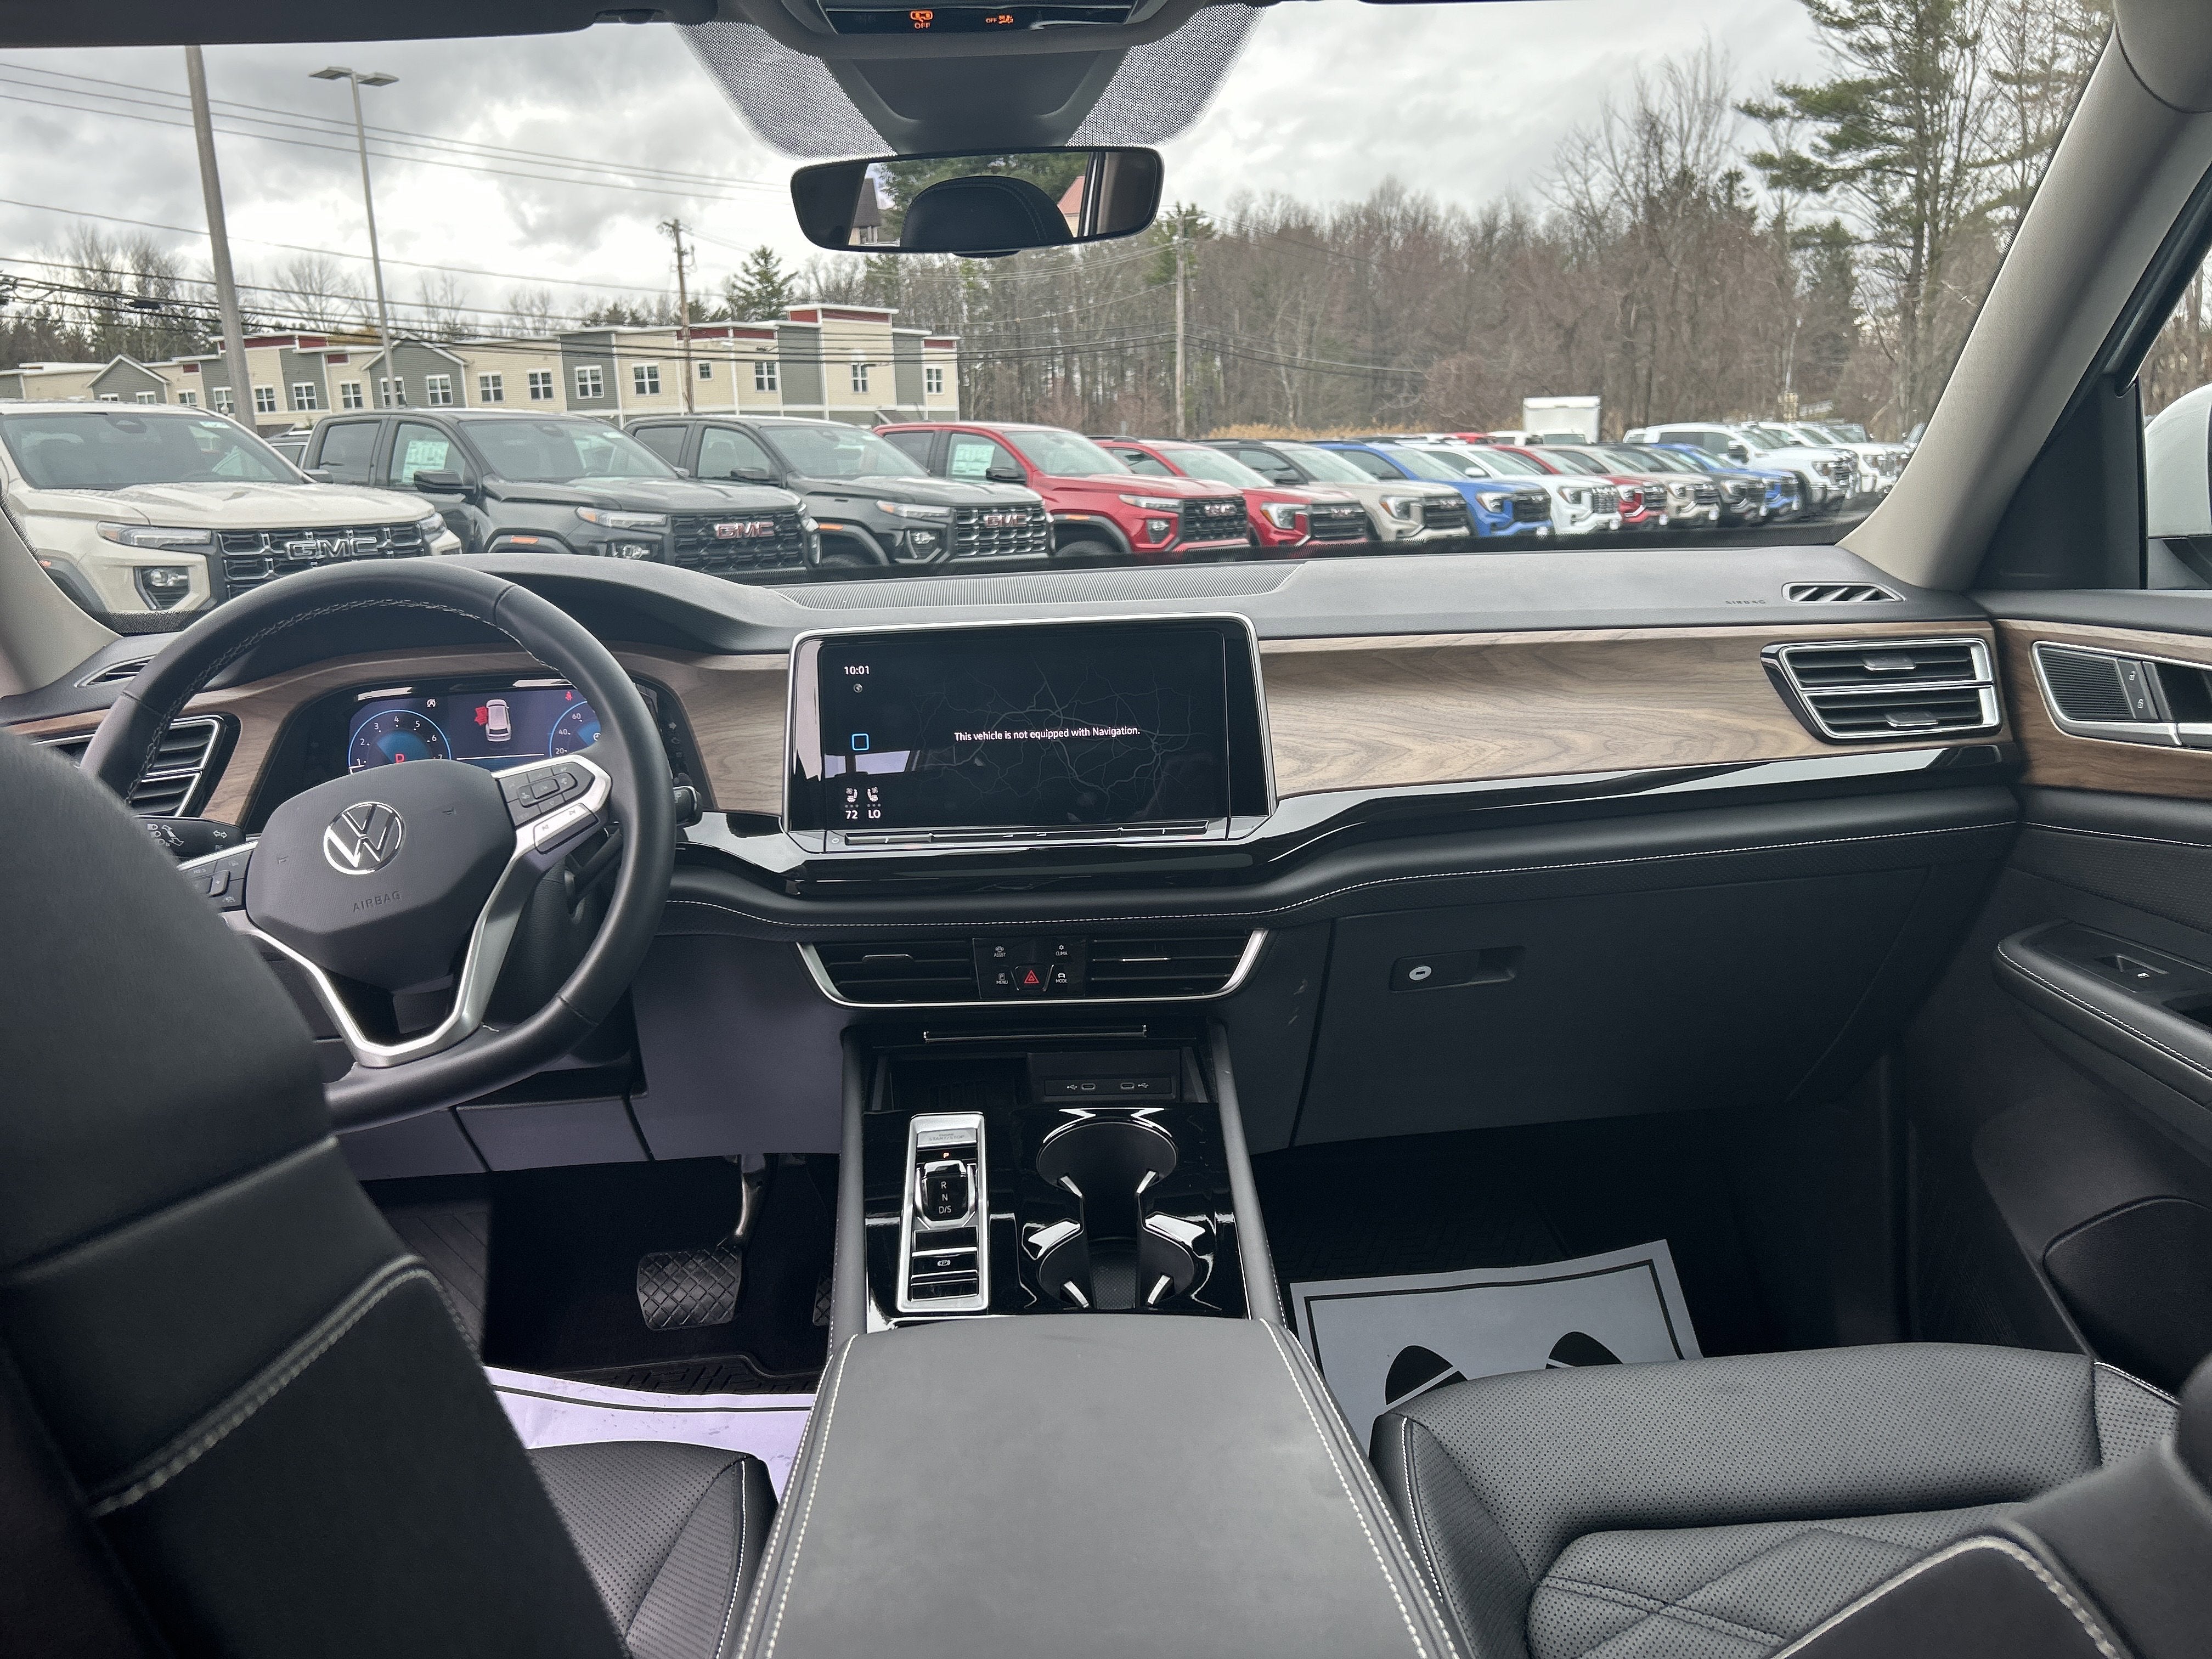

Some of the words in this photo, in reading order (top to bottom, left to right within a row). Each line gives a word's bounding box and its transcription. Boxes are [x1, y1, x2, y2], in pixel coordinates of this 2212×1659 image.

[984, 514, 1027, 528] GMC
[714, 521, 775, 539] GMC
[285, 537, 377, 560] GMC
[844, 665, 870, 675] 10:01
[954, 732, 972, 741] This
[973, 731, 1003, 740] vehicle
[1005, 730, 1012, 739] is
[1013, 731, 1028, 739] not
[1030, 728, 1069, 739] equipped
[1071, 727, 1090, 736] with
[1092, 726, 1141, 737] Navigation.
[395, 753, 405, 763] P
[845, 810, 858, 819] 72
[868, 809, 881, 819] LO
[324, 802, 406, 874] VW
[353, 890, 401, 912] AIRBAG
[942, 1193, 948, 1201] N
[939, 1205, 952, 1214] D/S
